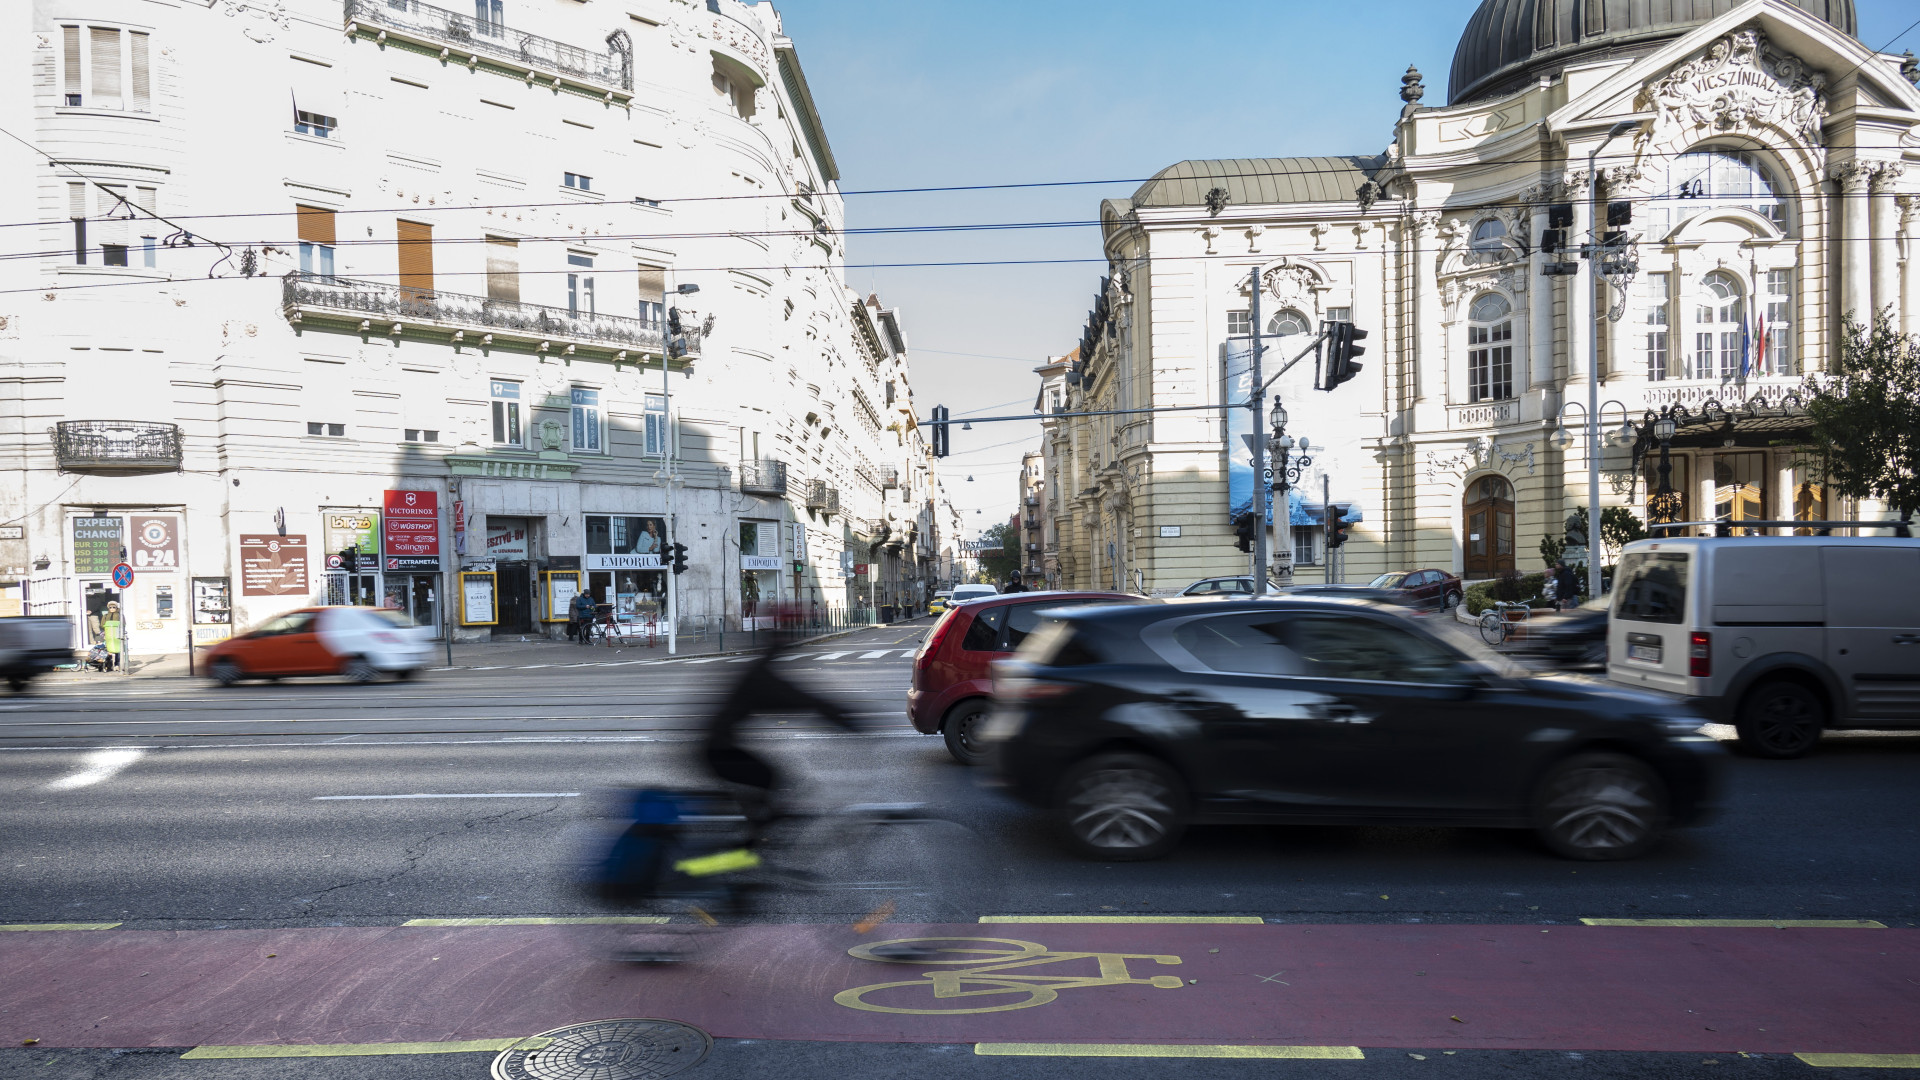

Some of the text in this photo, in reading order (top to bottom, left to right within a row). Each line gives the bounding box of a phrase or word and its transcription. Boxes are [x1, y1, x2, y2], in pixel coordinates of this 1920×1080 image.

[76, 518, 120, 526] EXPERT
[75, 530, 120, 538] CHANG
[395, 544, 430, 554] Solingen
[136, 549, 175, 566] 0-24
[601, 557, 662, 567] EMPORIUM
